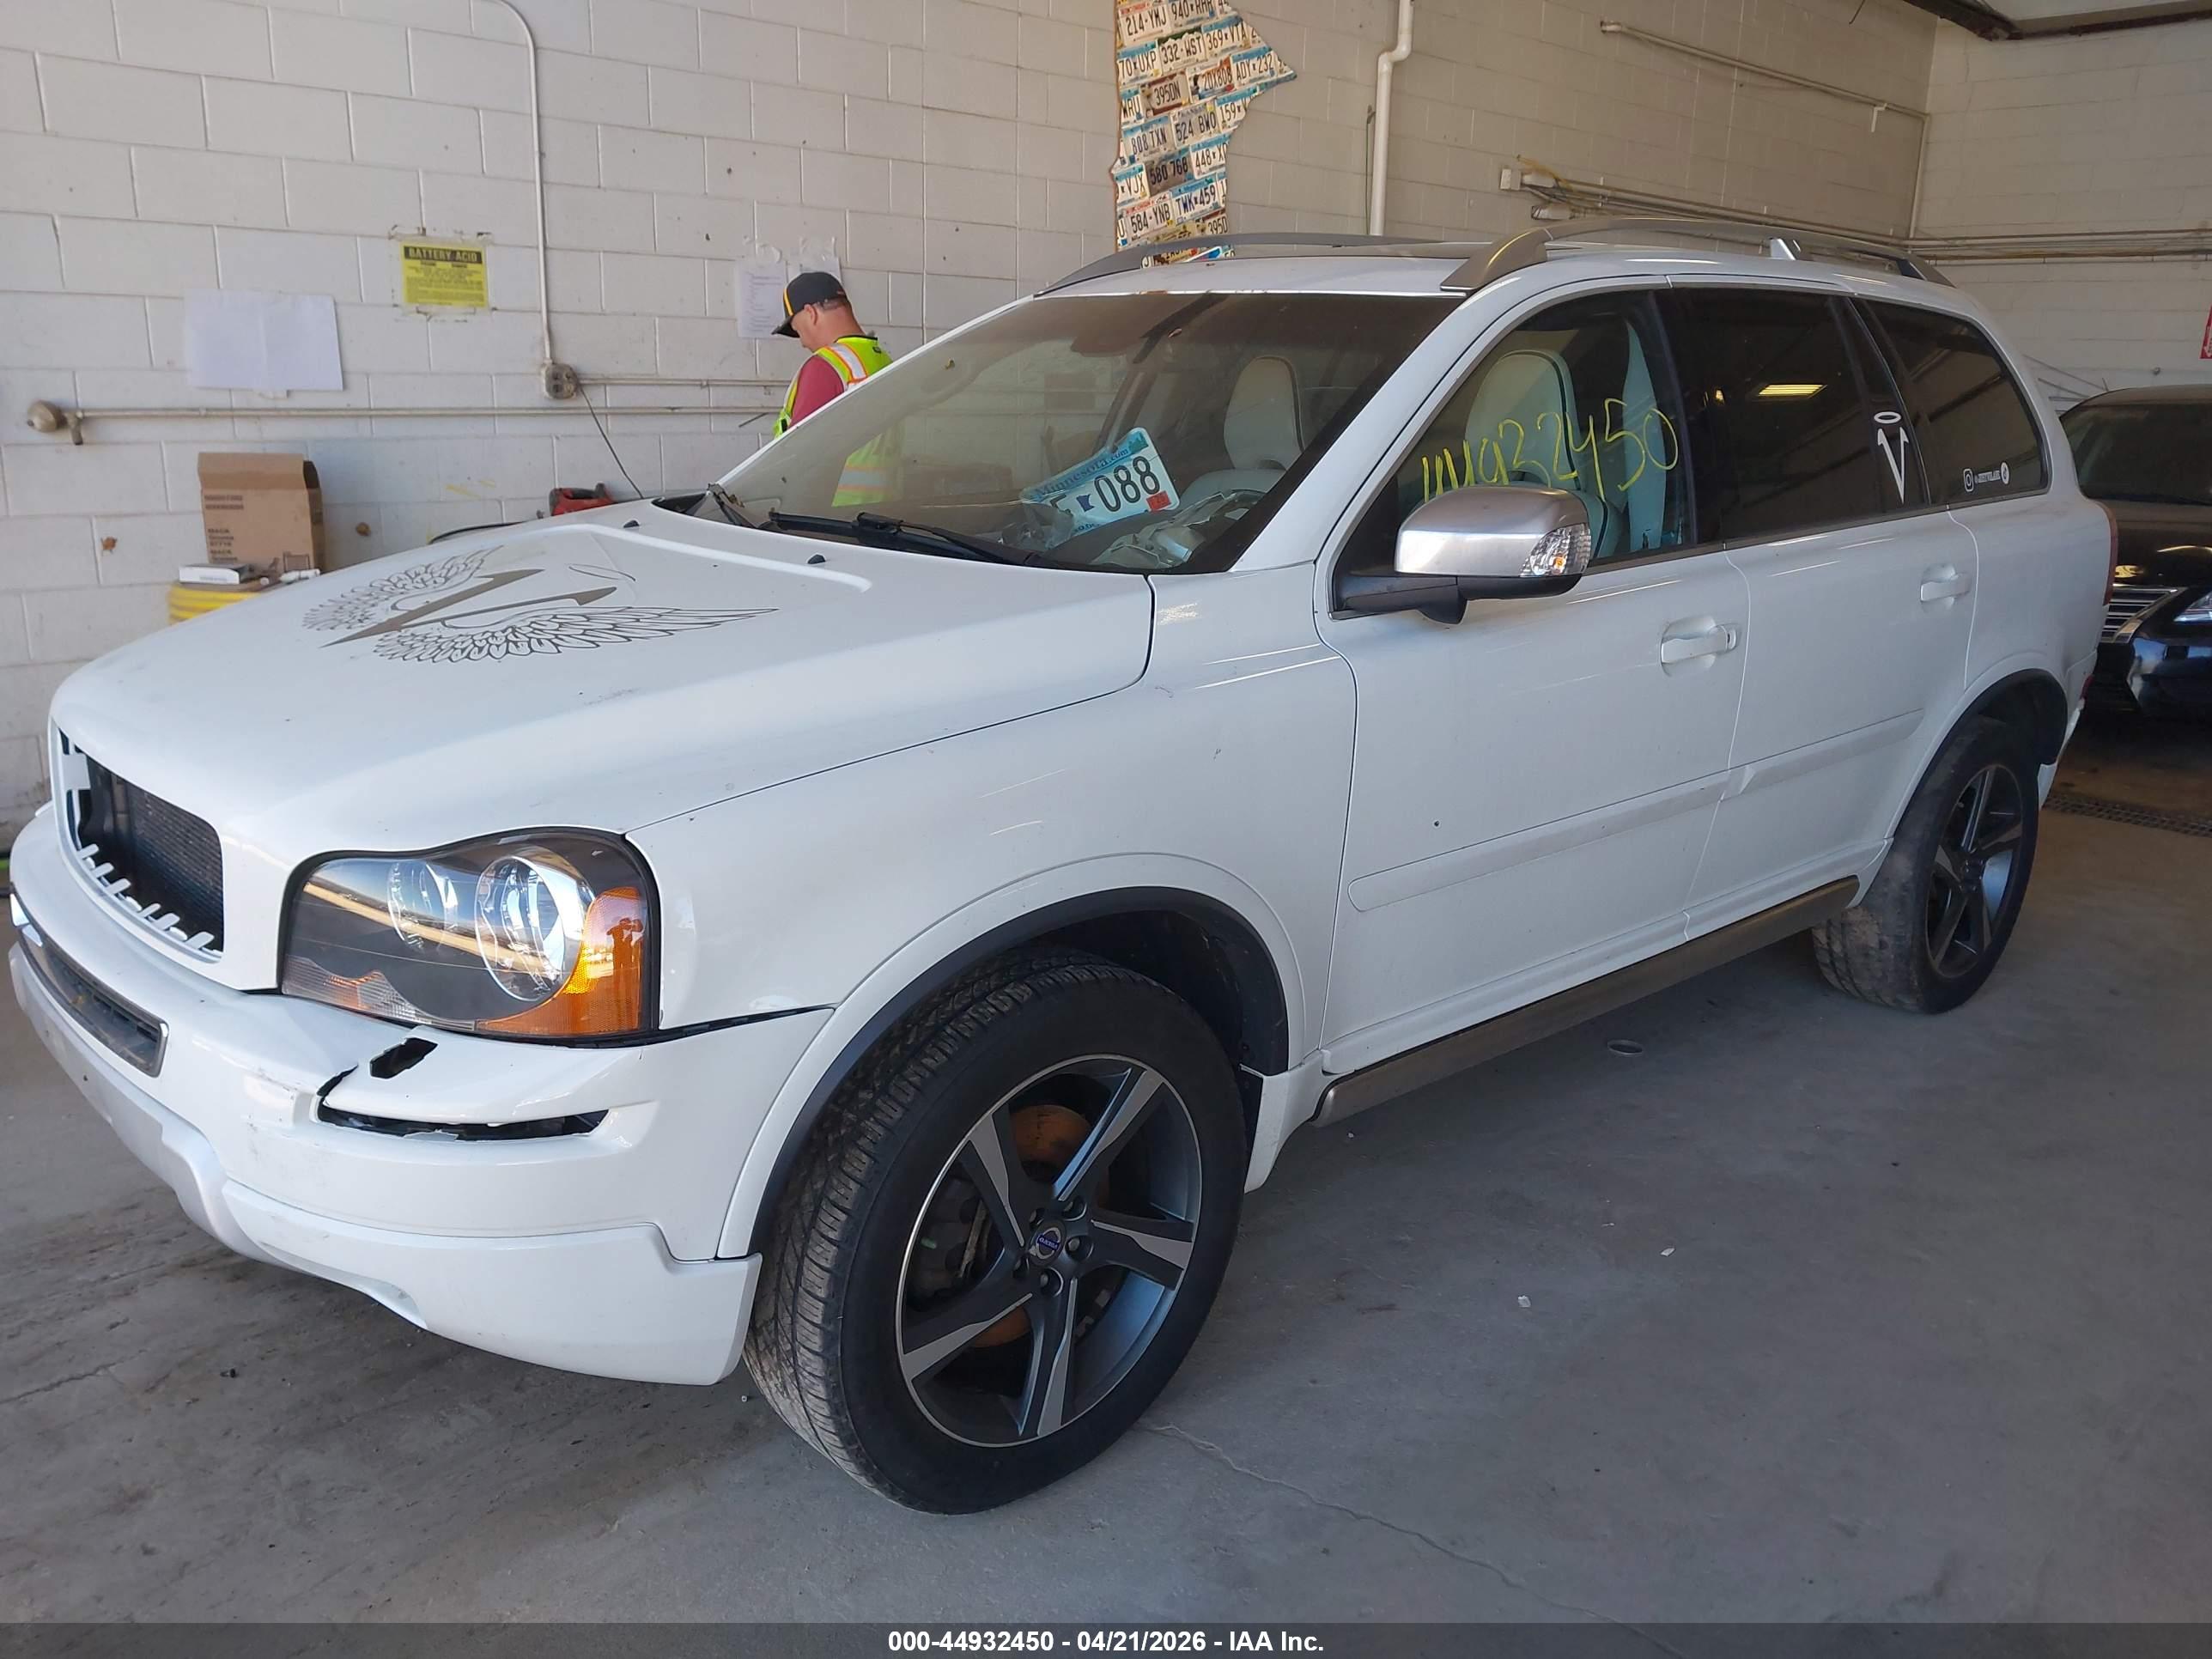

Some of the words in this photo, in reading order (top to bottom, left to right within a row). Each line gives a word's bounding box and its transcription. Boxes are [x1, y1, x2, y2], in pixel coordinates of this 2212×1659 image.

[409, 247, 451, 261] BATTERY
[456, 252, 477, 263] ACID
[1093, 455, 1161, 513] 088
